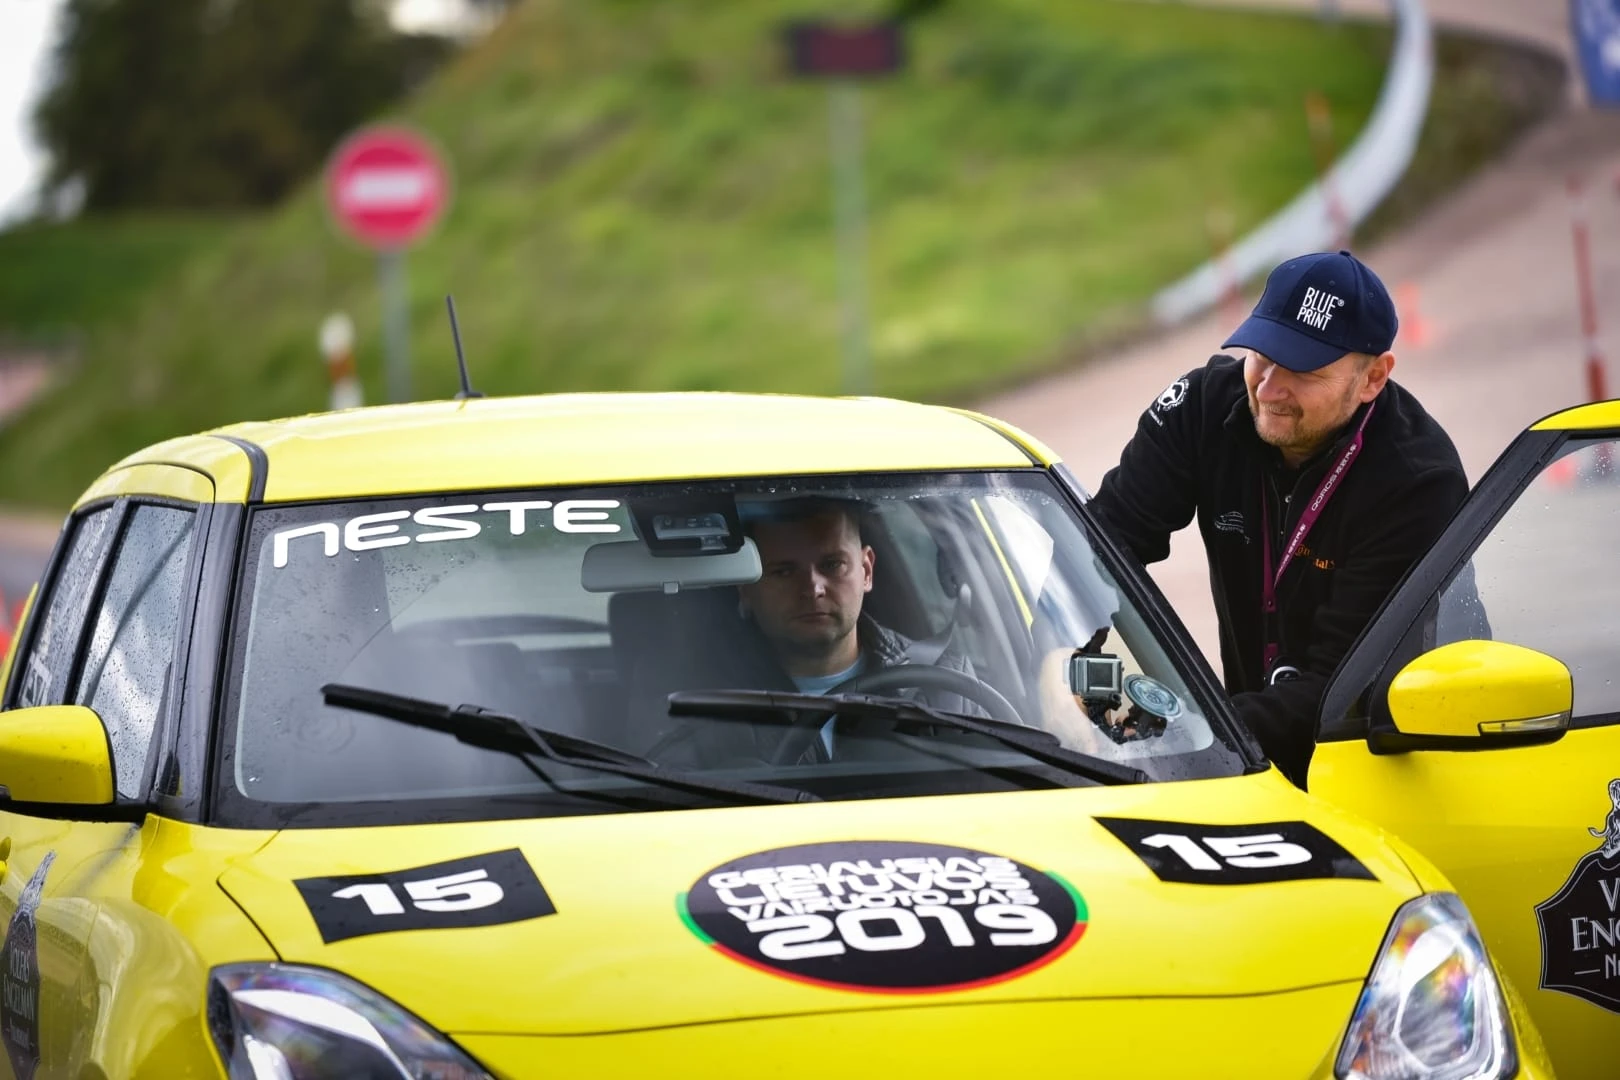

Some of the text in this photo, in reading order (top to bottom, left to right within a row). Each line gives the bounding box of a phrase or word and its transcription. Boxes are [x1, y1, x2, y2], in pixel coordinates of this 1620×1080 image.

[1296, 306, 1332, 331] PRINT
[273, 499, 621, 568] NESTE
[1141, 833, 1312, 871] 15
[332, 868, 504, 916] 15
[715, 871, 1030, 907] LIETUVOS
[727, 887, 1039, 922] VAIRUOTOJAS
[746, 903, 1057, 960] 2019
